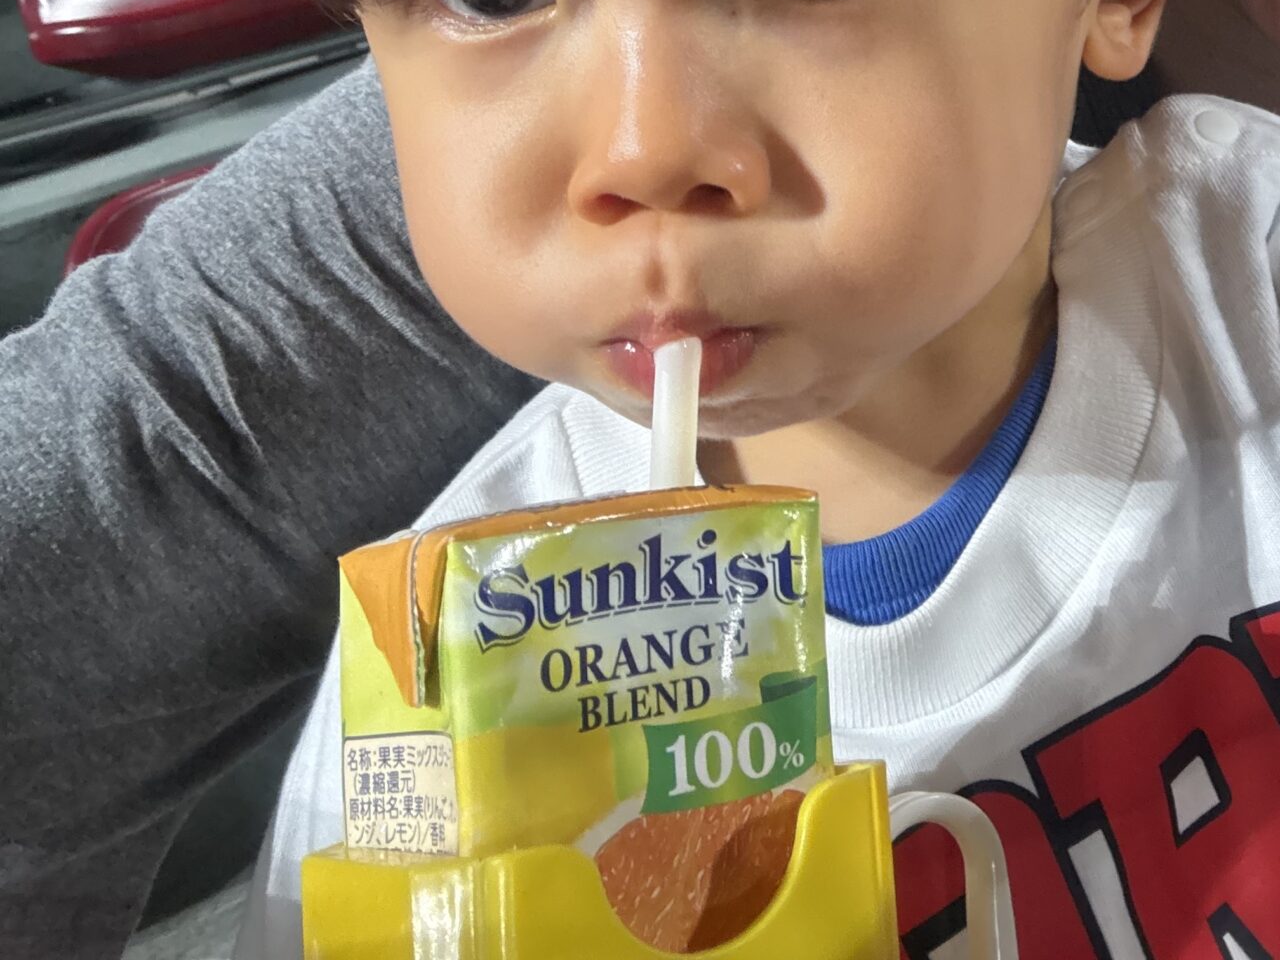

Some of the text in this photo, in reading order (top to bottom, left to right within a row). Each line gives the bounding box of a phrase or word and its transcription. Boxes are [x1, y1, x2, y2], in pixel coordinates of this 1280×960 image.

[475, 529, 808, 653] Sunkist
[540, 617, 750, 693] ORANGE
[578, 675, 711, 734] BLEND
[664, 721, 805, 799] 100%
